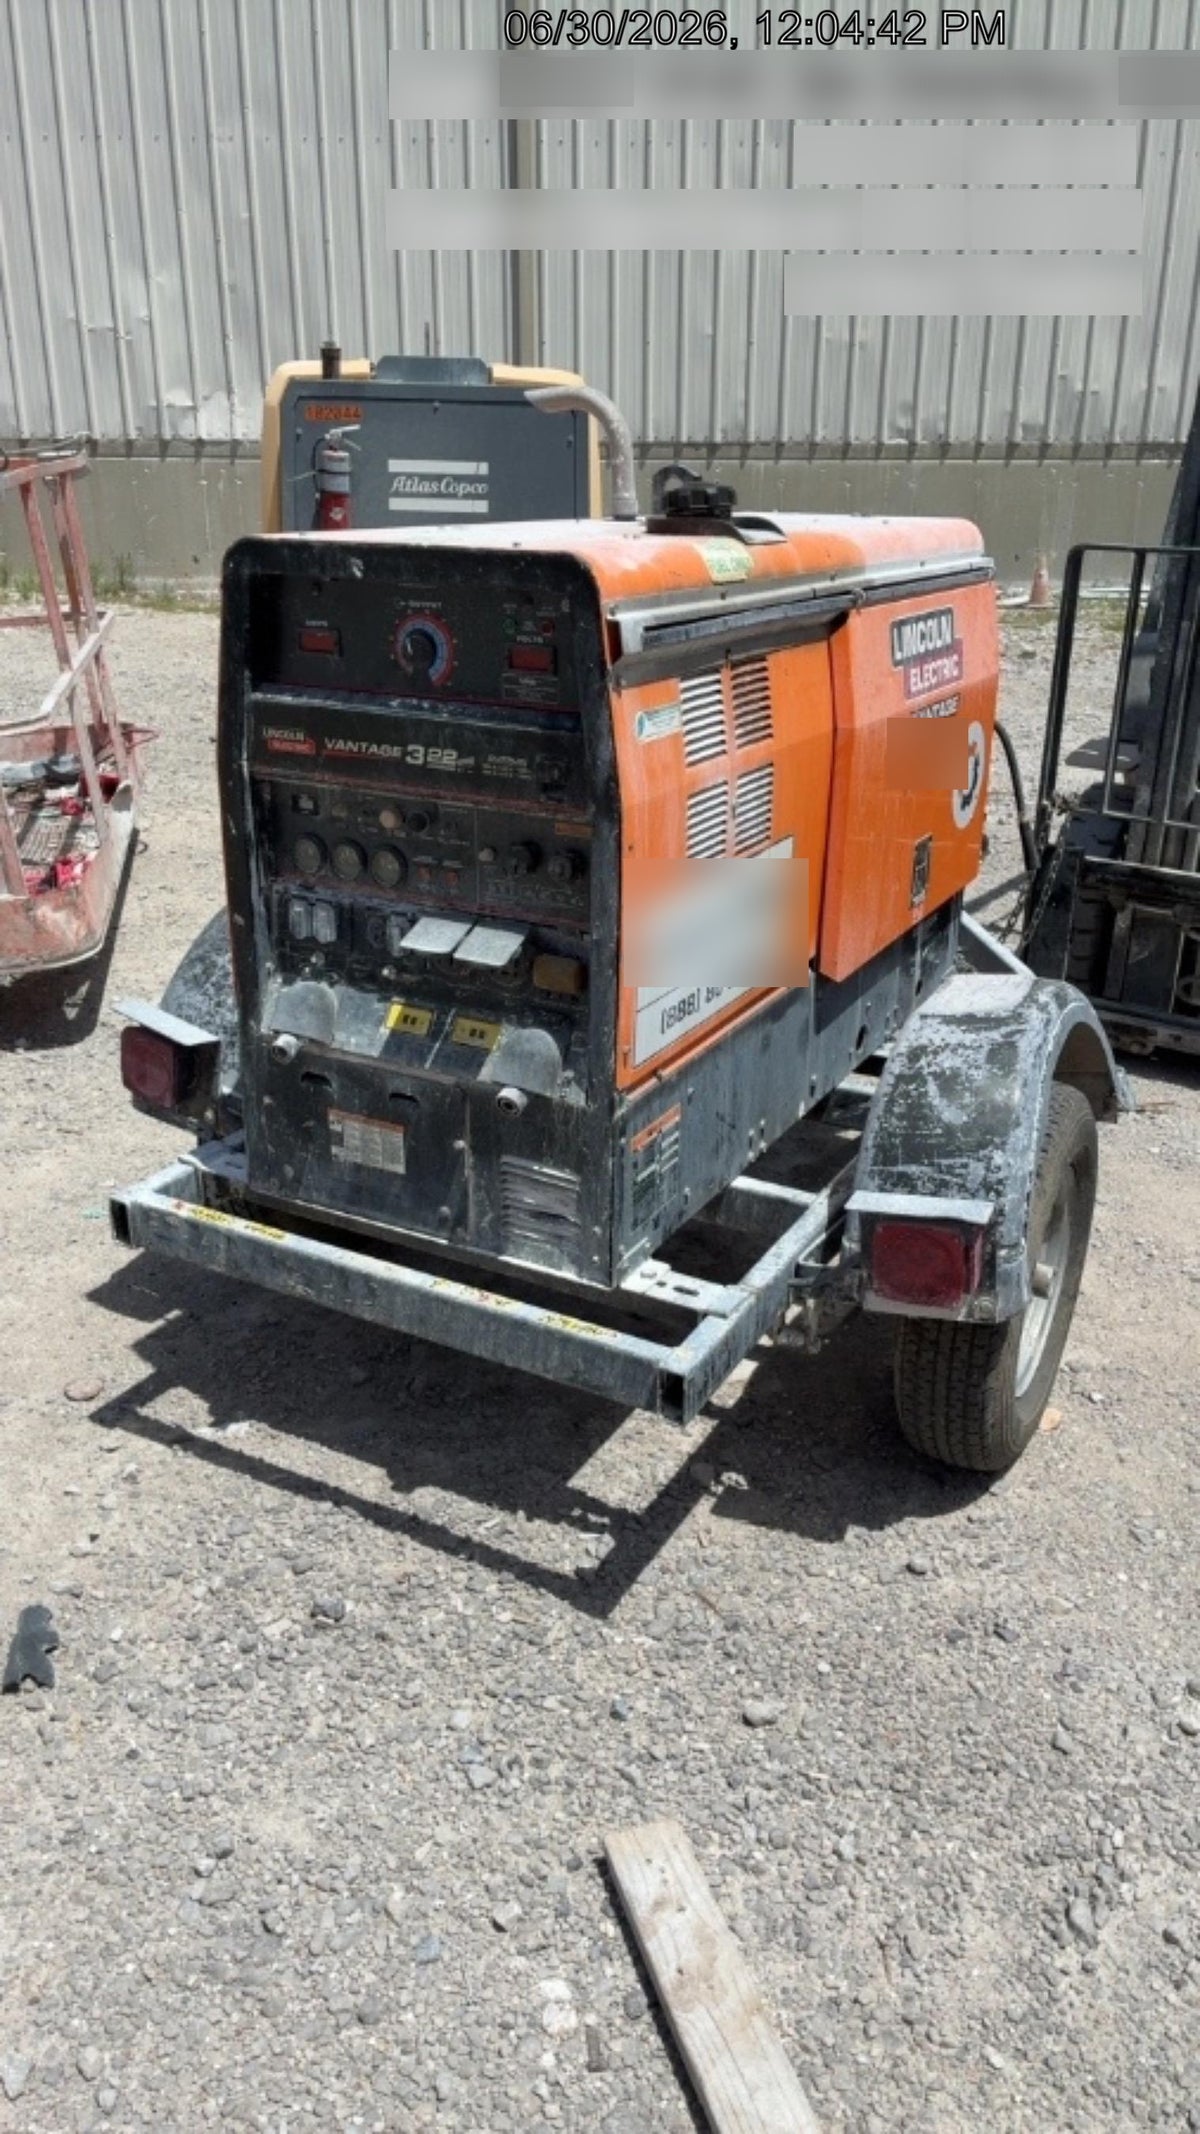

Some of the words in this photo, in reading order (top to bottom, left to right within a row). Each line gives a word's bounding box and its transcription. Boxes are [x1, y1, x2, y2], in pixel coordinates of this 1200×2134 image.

[893, 613, 953, 661] LINCOLN
[909, 653, 960, 694] ELECTRIC
[325, 738, 402, 757] VANTAGE
